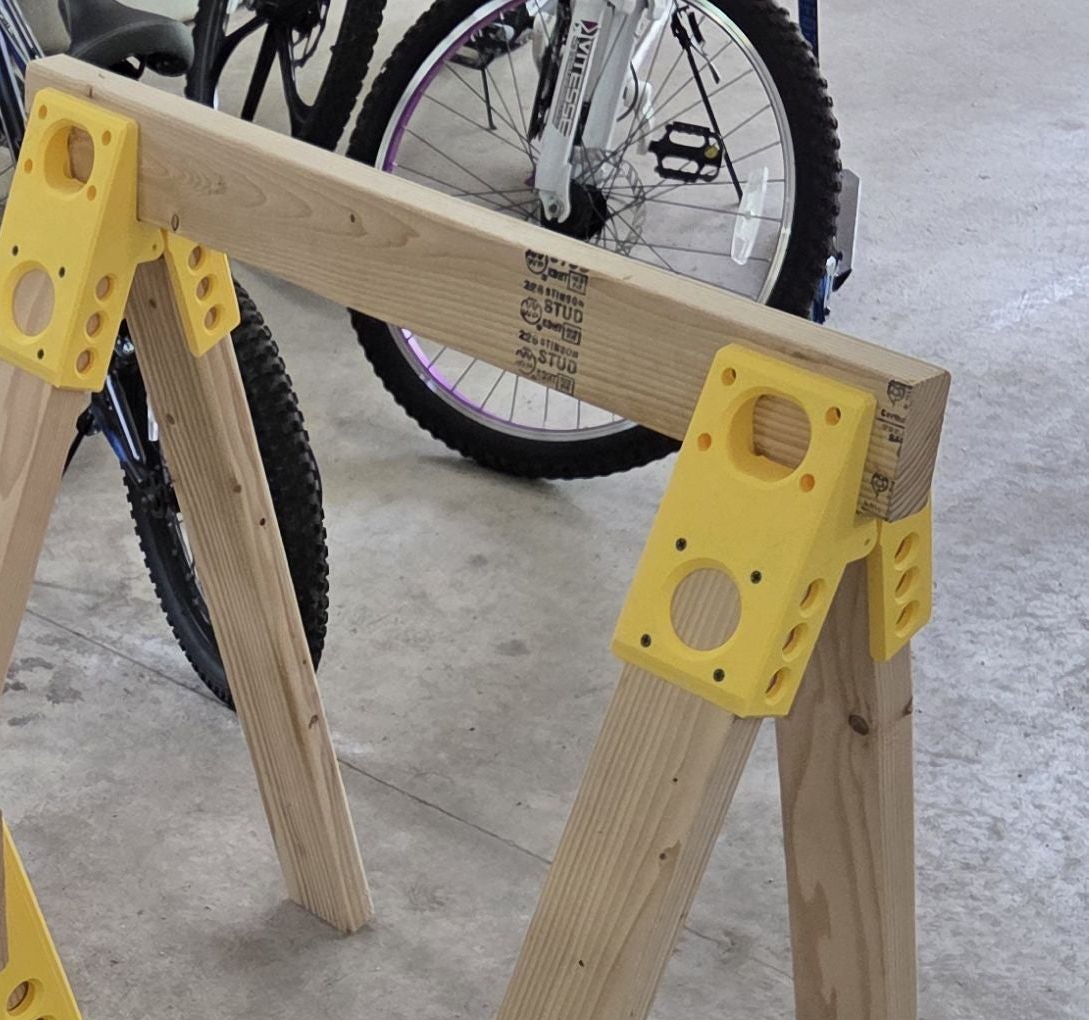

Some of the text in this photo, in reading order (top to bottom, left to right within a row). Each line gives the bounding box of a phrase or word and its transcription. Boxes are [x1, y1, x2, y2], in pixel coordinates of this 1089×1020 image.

[558, 40, 592, 137] VITESSE
[544, 298, 583, 323] STUD
[538, 349, 577, 374] STUD
